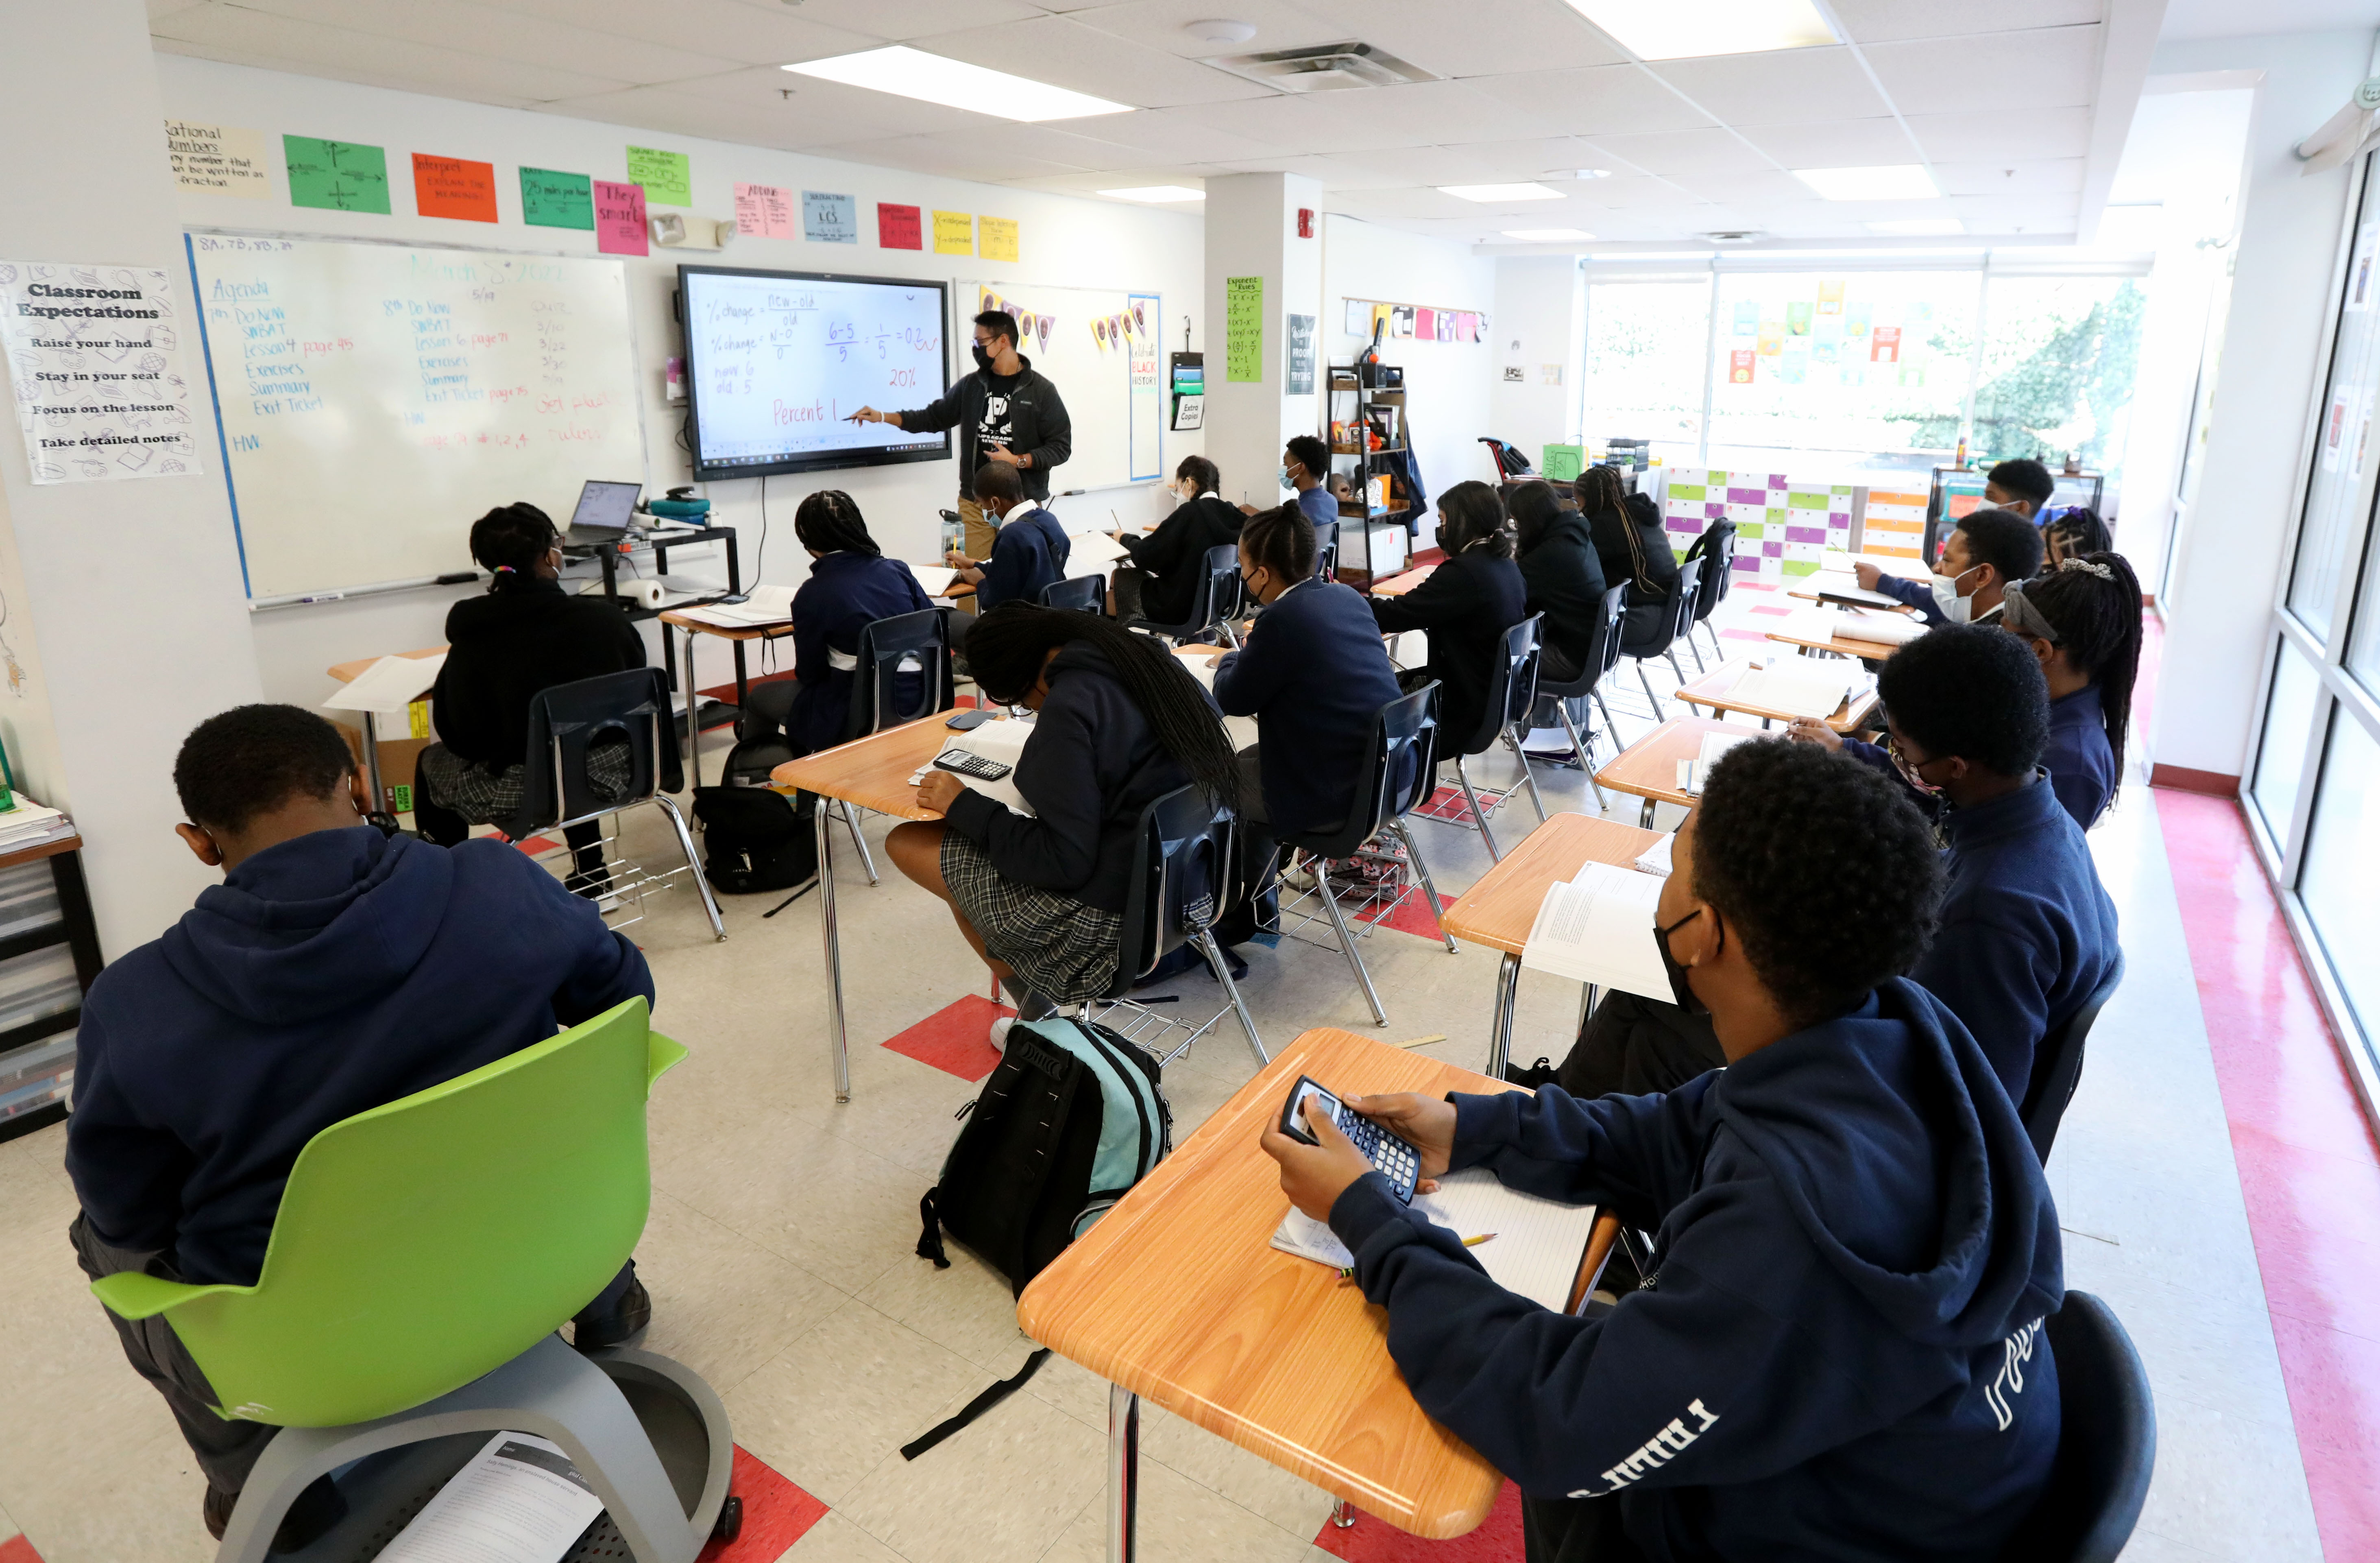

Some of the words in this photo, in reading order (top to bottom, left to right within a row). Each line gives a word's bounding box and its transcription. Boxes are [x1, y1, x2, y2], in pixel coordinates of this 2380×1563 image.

[188, 164, 203, 173] be
[229, 157, 251, 168] that
[607, 186, 635, 208] They
[1227, 277, 1258, 286] Exponent
[28, 284, 142, 299] Classroom
[214, 277, 269, 306] Agenda
[408, 299, 423, 315] Do
[800, 293, 815, 307] old
[17, 303, 159, 319] Expectations
[234, 307, 255, 325] Do
[722, 302, 754, 325] change
[783, 311, 797, 325] old
[31, 338, 72, 347] Raise
[76, 340, 111, 349] your
[116, 339, 152, 348] hand
[244, 342, 286, 358] Lesson
[286, 338, 296, 352] 4
[304, 341, 333, 358] page
[415, 336, 451, 351] Lesson
[456, 332, 466, 346] 6
[471, 334, 497, 350] page
[724, 334, 757, 354] change
[878, 339, 885, 359] 5
[839, 346, 846, 362] 5
[1131, 343, 1157, 358] Celebrate
[418, 355, 469, 369] Exercises
[745, 360, 754, 375] 6
[1132, 361, 1156, 373] BLACK
[35, 372, 68, 383] Stay
[93, 373, 126, 382] your
[246, 362, 305, 378] Exercises
[1291, 372, 1311, 381] TRYING
[421, 371, 468, 386] Summary
[889, 367, 916, 389] 20%
[1132, 376, 1157, 385] HISTORY
[250, 381, 310, 396] Summary
[744, 379, 752, 393] 5
[424, 387, 448, 402] Exit
[488, 389, 513, 404] page
[33, 405, 76, 414] Focus
[81, 405, 99, 413] on
[104, 404, 128, 413] the
[131, 404, 175, 412] lesson
[253, 399, 282, 416] Exit
[285, 396, 324, 412] Ticket
[773, 399, 823, 426] Percent
[1181, 413, 1198, 421] Copies
[39, 438, 76, 448] Take
[80, 436, 139, 446] detailed
[142, 434, 181, 443] notes
[525, 1470, 546, 1480] enslaved
[546, 1478, 560, 1487] house
[560, 1485, 578, 1496] servant
